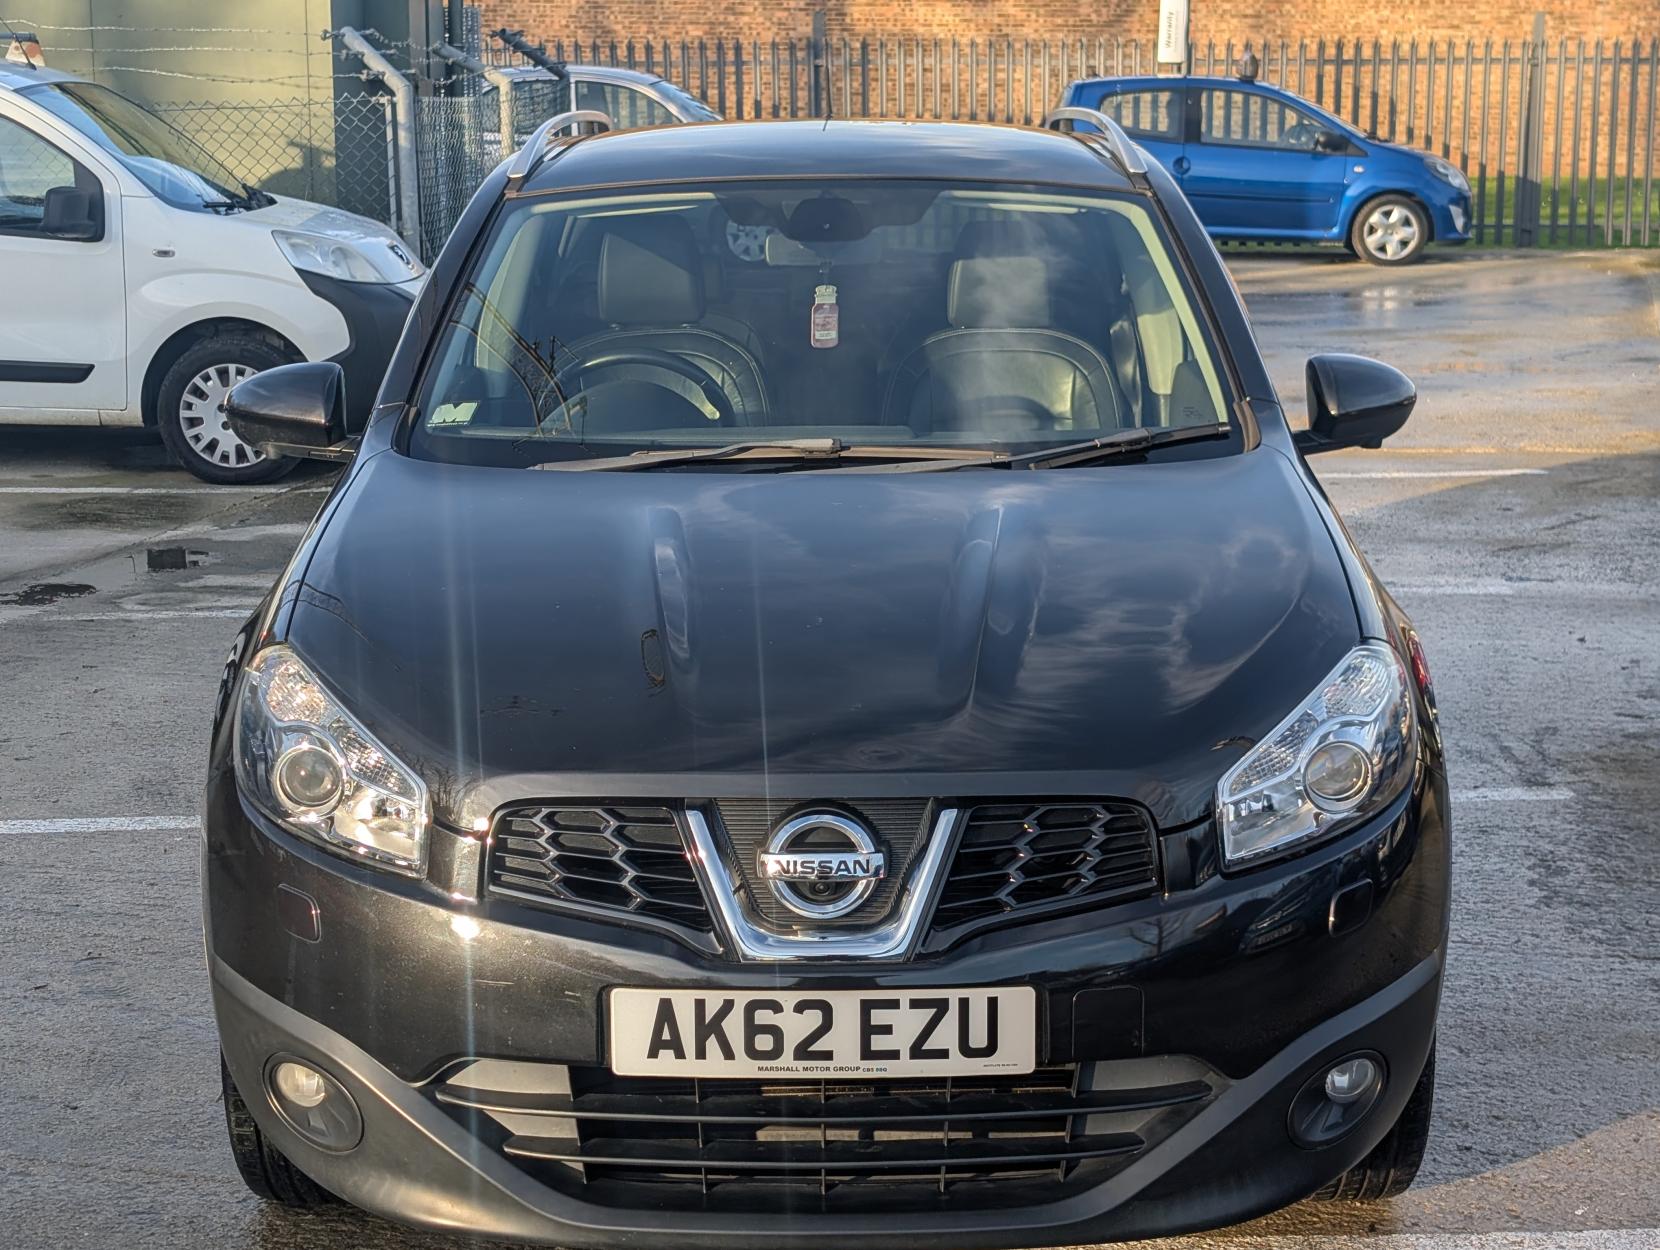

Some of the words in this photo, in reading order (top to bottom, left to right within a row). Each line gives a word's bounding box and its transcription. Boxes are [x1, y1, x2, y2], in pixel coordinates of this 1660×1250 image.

[773, 859, 870, 875] NISSAN
[646, 996, 834, 1061] AK62
[860, 996, 999, 1061] EZU
[757, 1065, 800, 1073] MARSHALL
